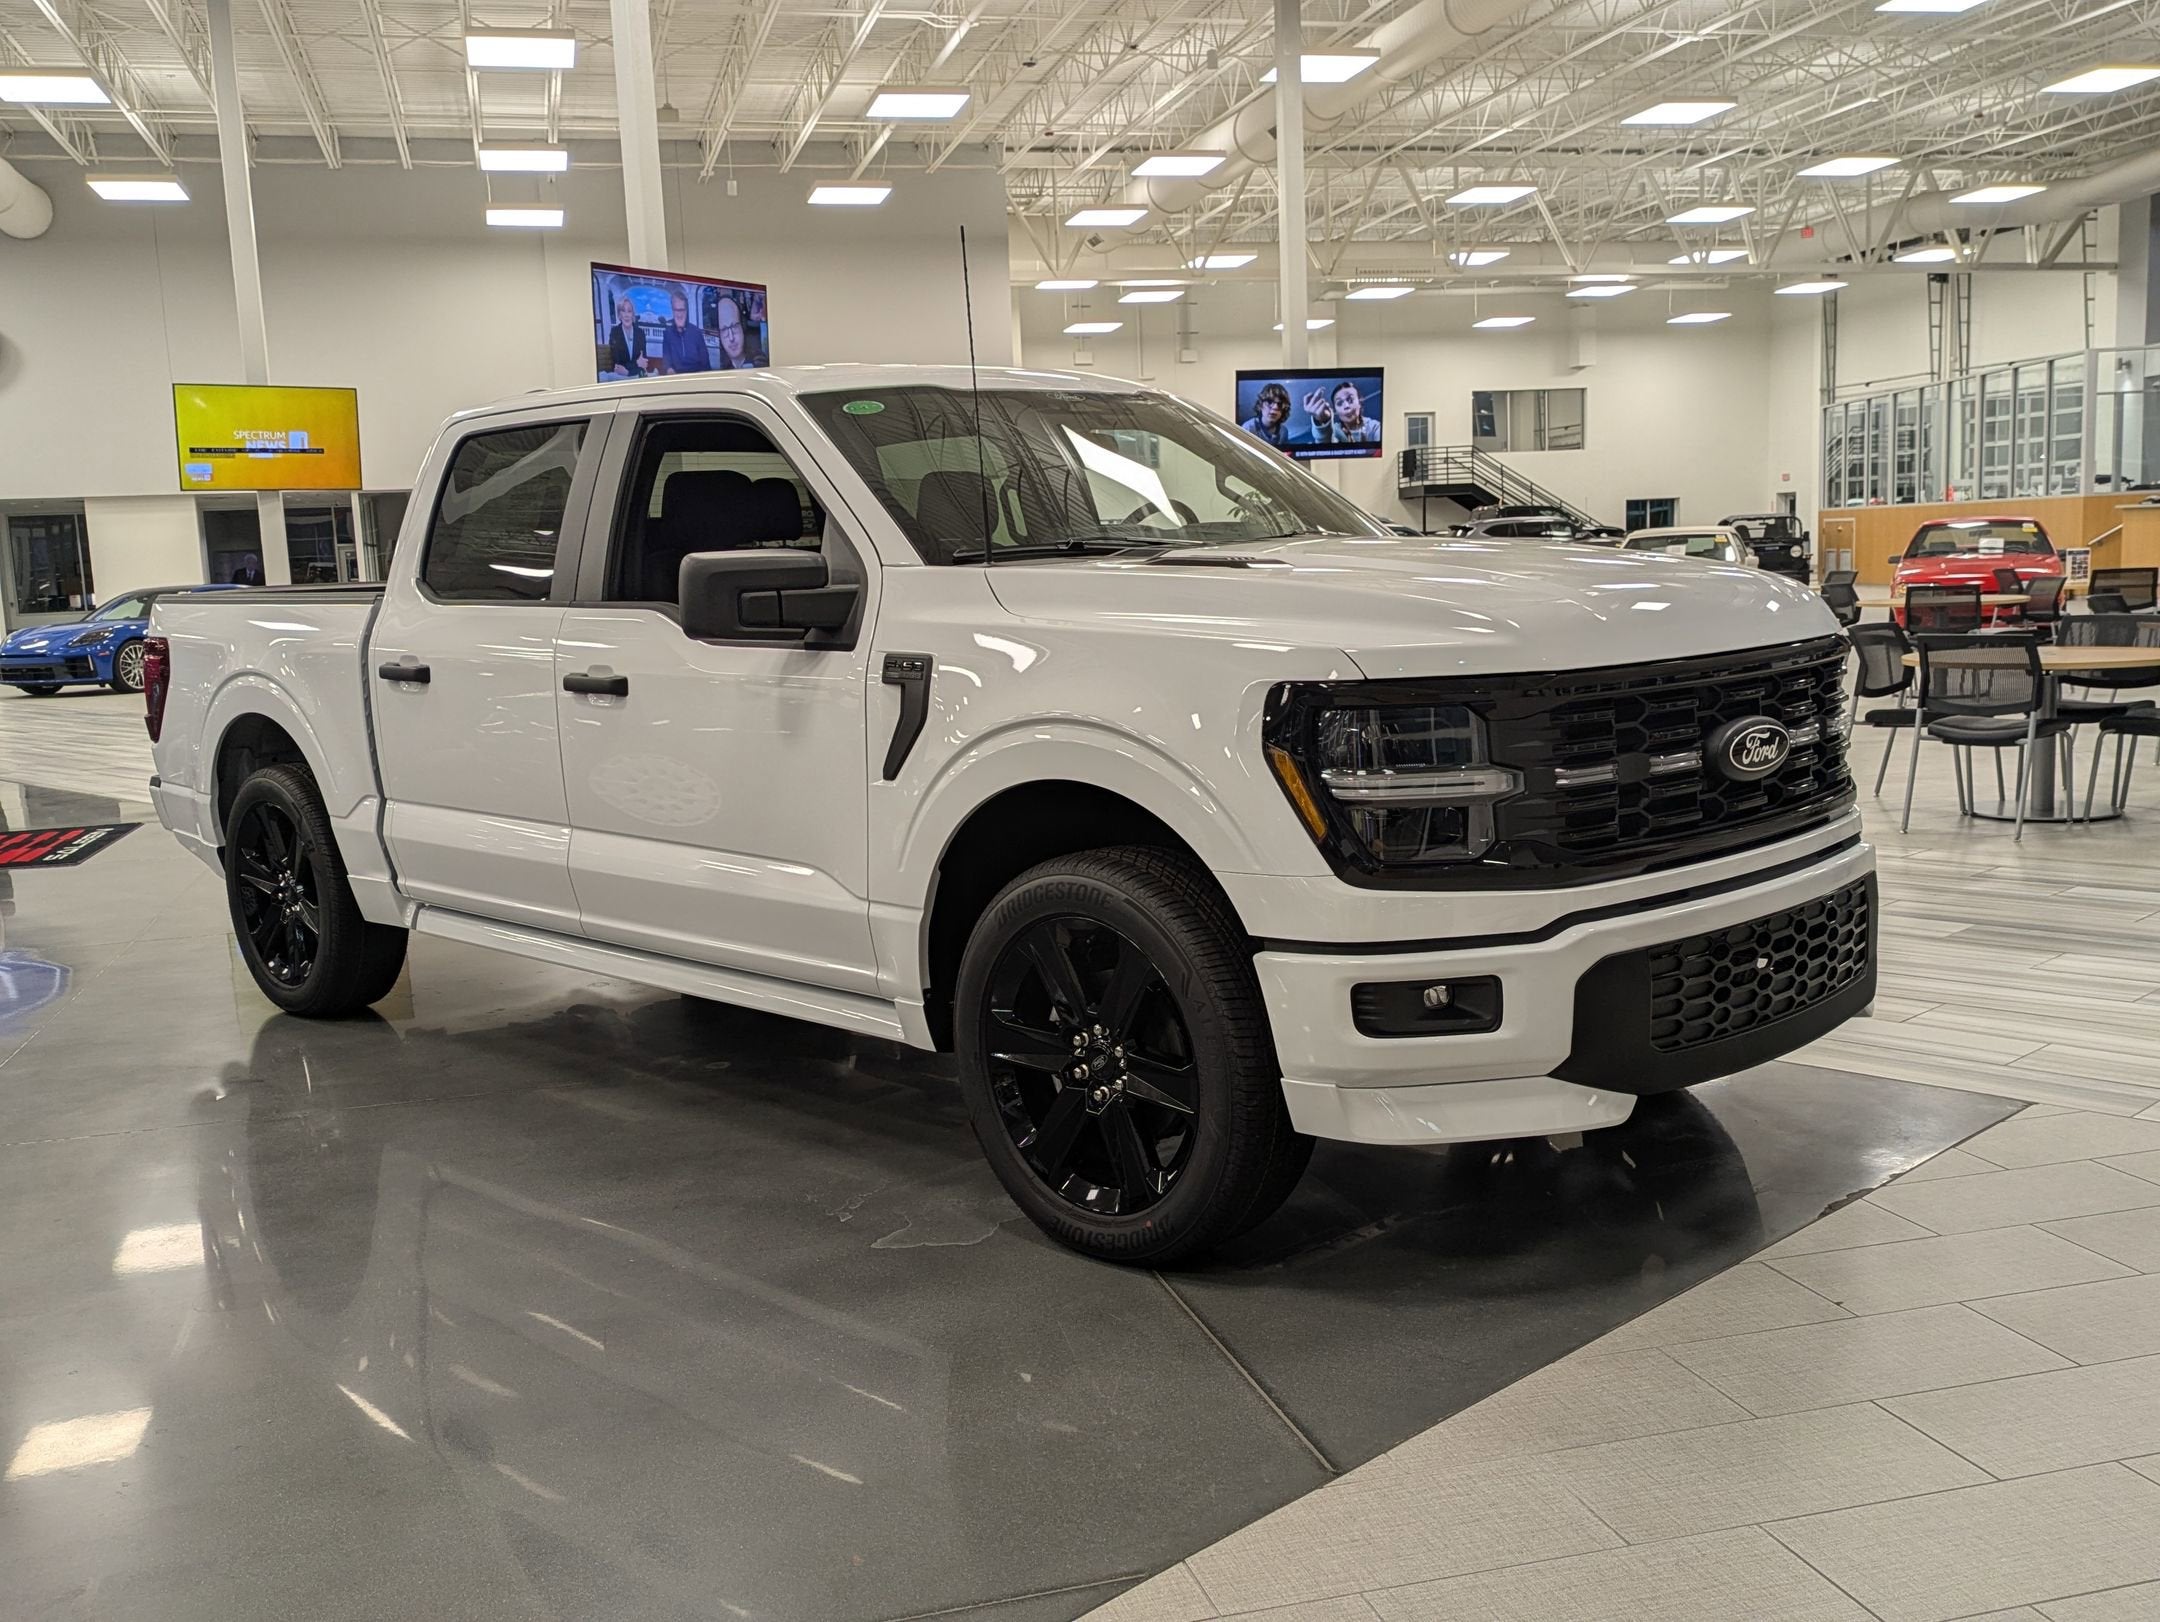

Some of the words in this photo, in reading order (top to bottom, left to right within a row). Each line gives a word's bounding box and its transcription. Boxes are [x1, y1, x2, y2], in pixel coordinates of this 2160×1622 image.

[233, 430, 287, 440] SPECTRUM
[245, 440, 287, 450] NEWS
[1742, 731, 1780, 765] Ford
[994, 880, 1114, 928] BRIDGESTONE
